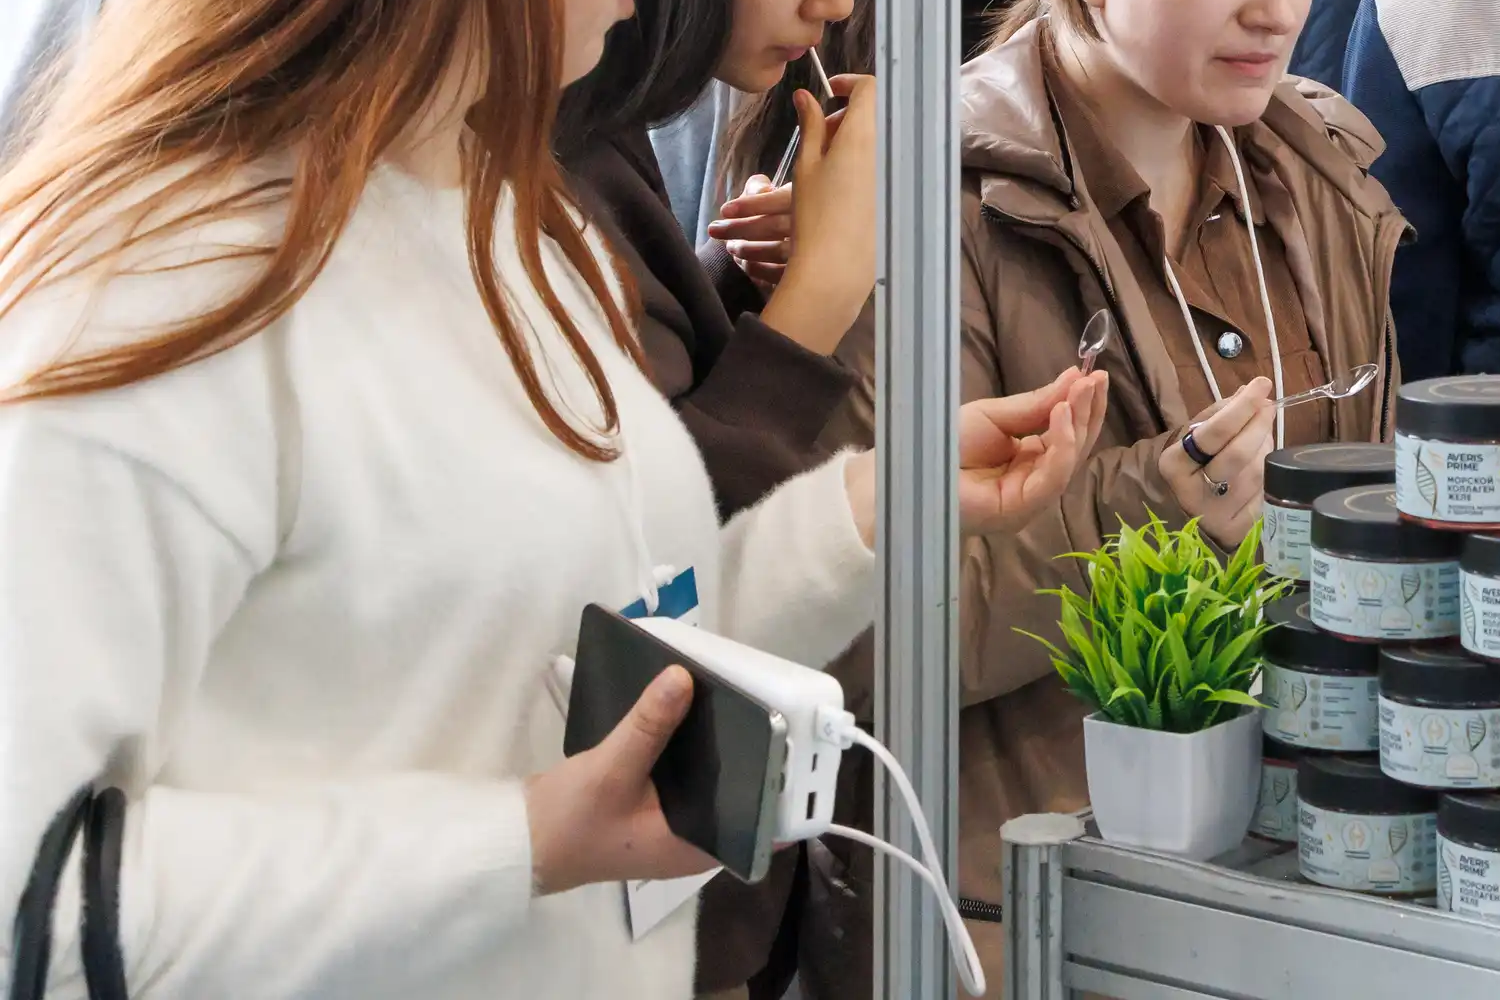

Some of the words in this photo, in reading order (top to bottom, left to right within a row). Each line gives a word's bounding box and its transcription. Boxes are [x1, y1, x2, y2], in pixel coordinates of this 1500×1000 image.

[1447, 453, 1484, 463] AVERIS
[1447, 462, 1479, 471] PRIME
[1447, 475, 1494, 485] МОРСКОЙ
